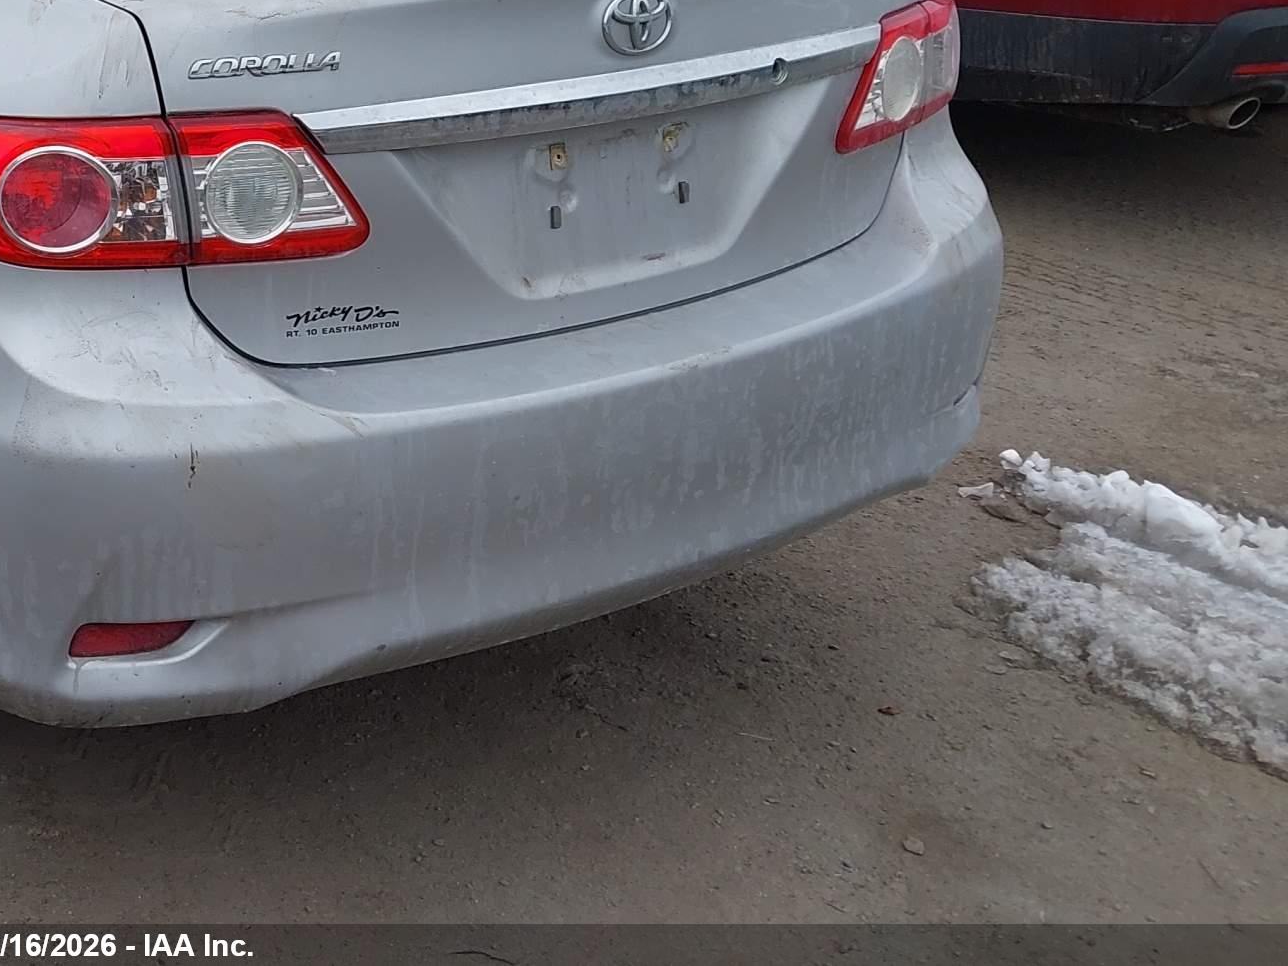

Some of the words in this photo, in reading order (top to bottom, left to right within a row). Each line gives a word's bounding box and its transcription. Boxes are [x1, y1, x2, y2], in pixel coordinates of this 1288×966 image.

[188, 50, 342, 80] COROLLA
[286, 305, 353, 328] Nicky
[354, 305, 400, 323] D's
[286, 330, 301, 338] RT.
[306, 328, 318, 336] 10
[322, 320, 400, 335] EASTHAMPTON
